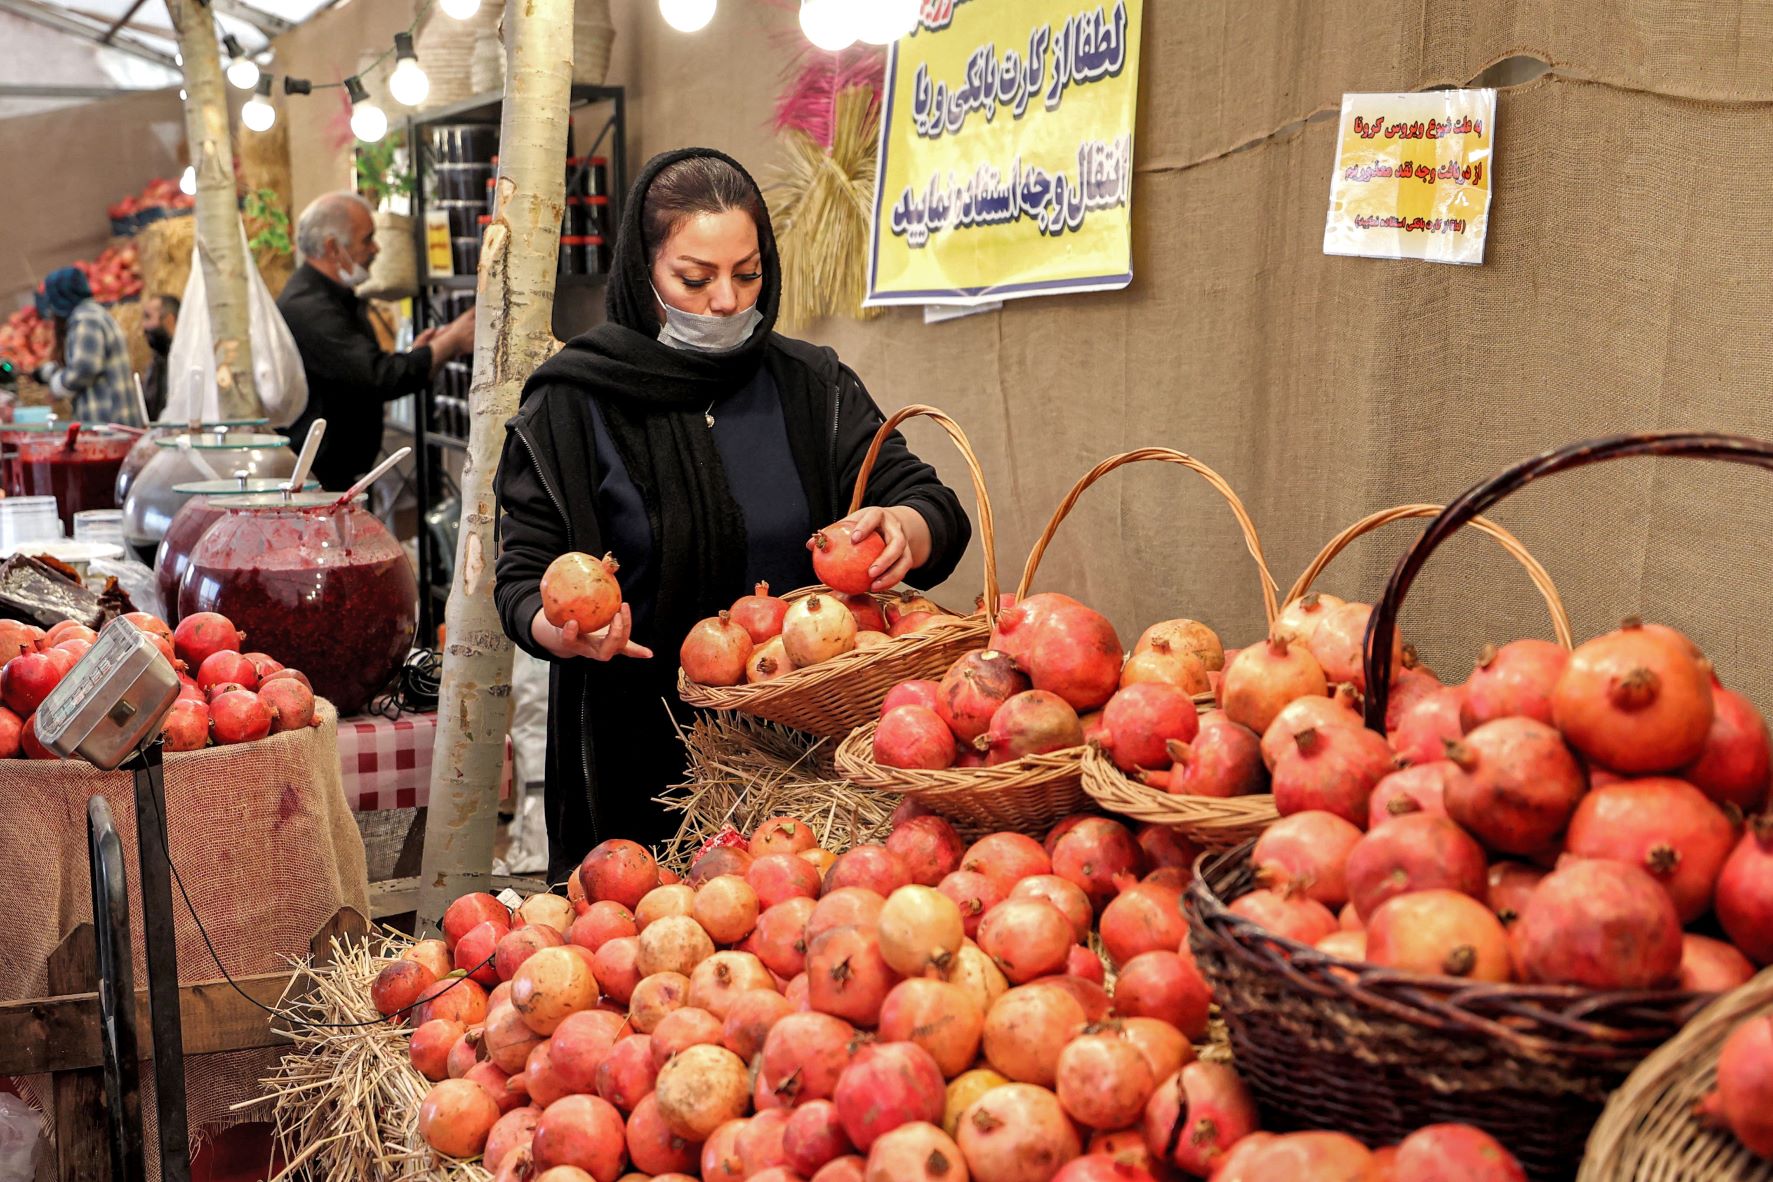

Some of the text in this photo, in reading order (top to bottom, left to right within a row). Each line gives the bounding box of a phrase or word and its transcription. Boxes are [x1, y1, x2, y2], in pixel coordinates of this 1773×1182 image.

[998, 24, 1050, 118] کارت
[1046, 16, 1074, 110] از
[1073, 0, 1126, 83] لطفا
[946, 42, 999, 131] بانکی
[1354, 115, 1483, 139] به علت شیوع ویروس کرونا
[891, 134, 1130, 247] انتقال وجه استفاده نمایید
[1344, 159, 1482, 185] از دریافت وجه نقد معذوریم
[1406, 216, 1425, 232] بانکی
